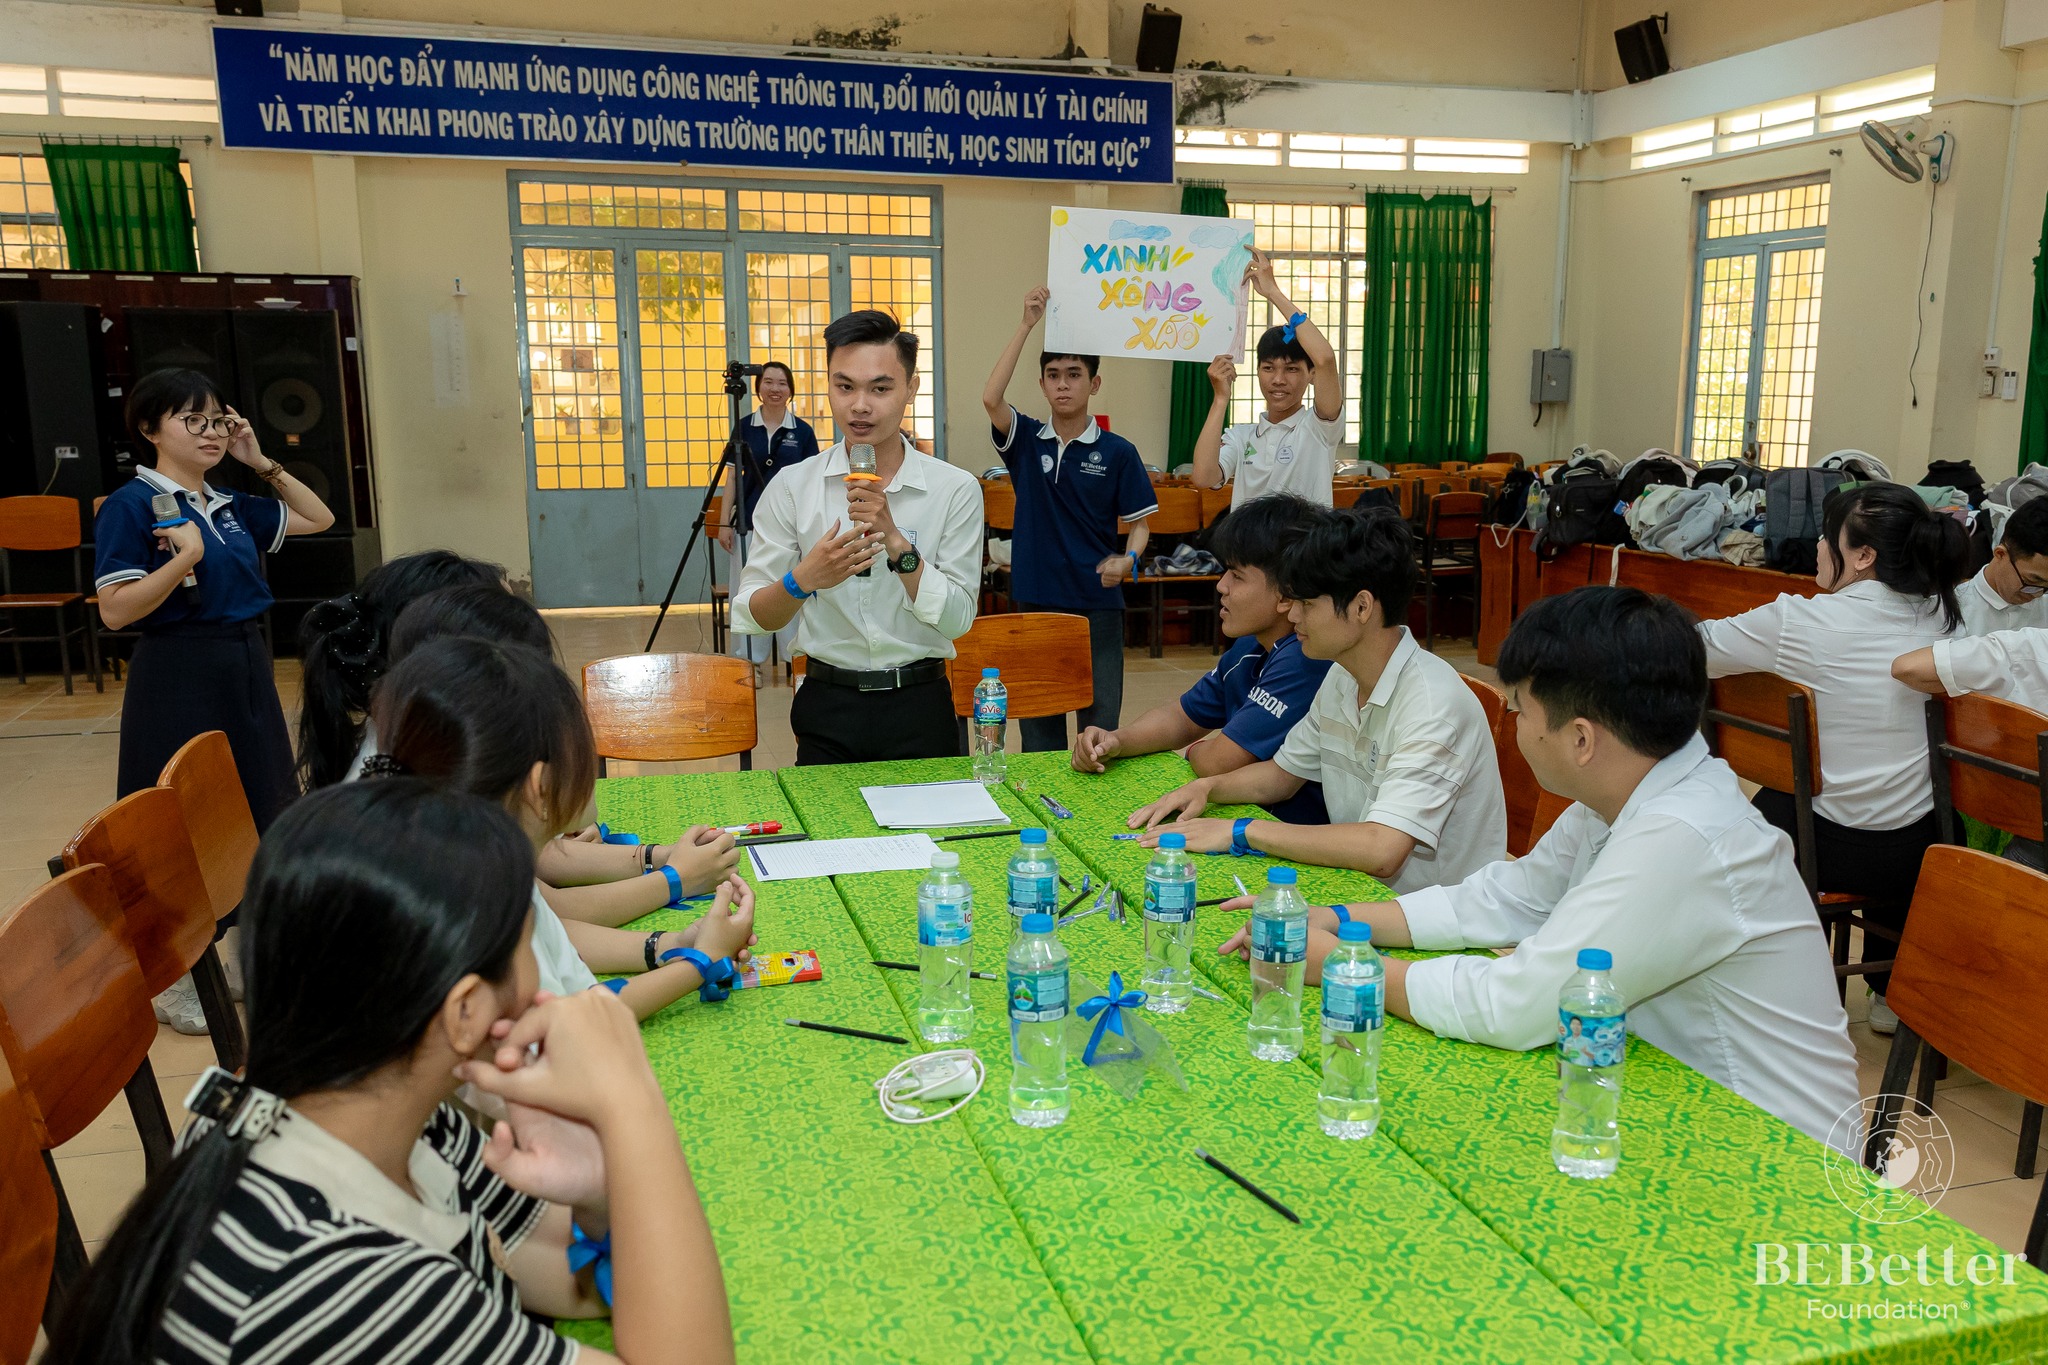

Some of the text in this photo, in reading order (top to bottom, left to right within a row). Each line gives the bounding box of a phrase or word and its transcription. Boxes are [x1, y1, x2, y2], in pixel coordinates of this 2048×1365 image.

[344, 55, 394, 92] HỌC
[400, 43, 446, 88] ĐẨY
[453, 60, 520, 96] MẠNH
[526, 54, 572, 94] ỨNG
[577, 66, 637, 102] DỤNG
[642, 64, 700, 100] CÔNG
[705, 70, 760, 109] NGHỆ
[766, 72, 836, 107] THÔNG
[840, 81, 880, 115] TIN,
[883, 72, 917, 112] ĐỔI
[923, 80, 961, 114] MỚI
[966, 80, 1018, 120] QUẢN
[1023, 87, 1047, 119] LÝ
[1056, 88, 1087, 121] TÀI
[1092, 91, 1148, 125] CHÍNH
[258, 94, 292, 132] VÀ
[297, 90, 370, 135] TRIỂN
[376, 106, 431, 137] KHAI
[437, 108, 514, 141] PHONG
[518, 107, 578, 142] TRÀO
[583, 109, 625, 144] XÂY
[632, 114, 691, 152] DỰNG
[695, 114, 779, 152] TRƯỜNG
[784, 125, 826, 160] HỌC
[831, 123, 885, 156] THÂN
[890, 126, 955, 165] THIỆN,
[960, 134, 1000, 167] HỌC
[1005, 136, 1048, 164] SINH
[1054, 133, 1096, 166] TÍCH
[1080, 243, 1171, 274] XANH
[1097, 275, 1202, 313] XÔNG
